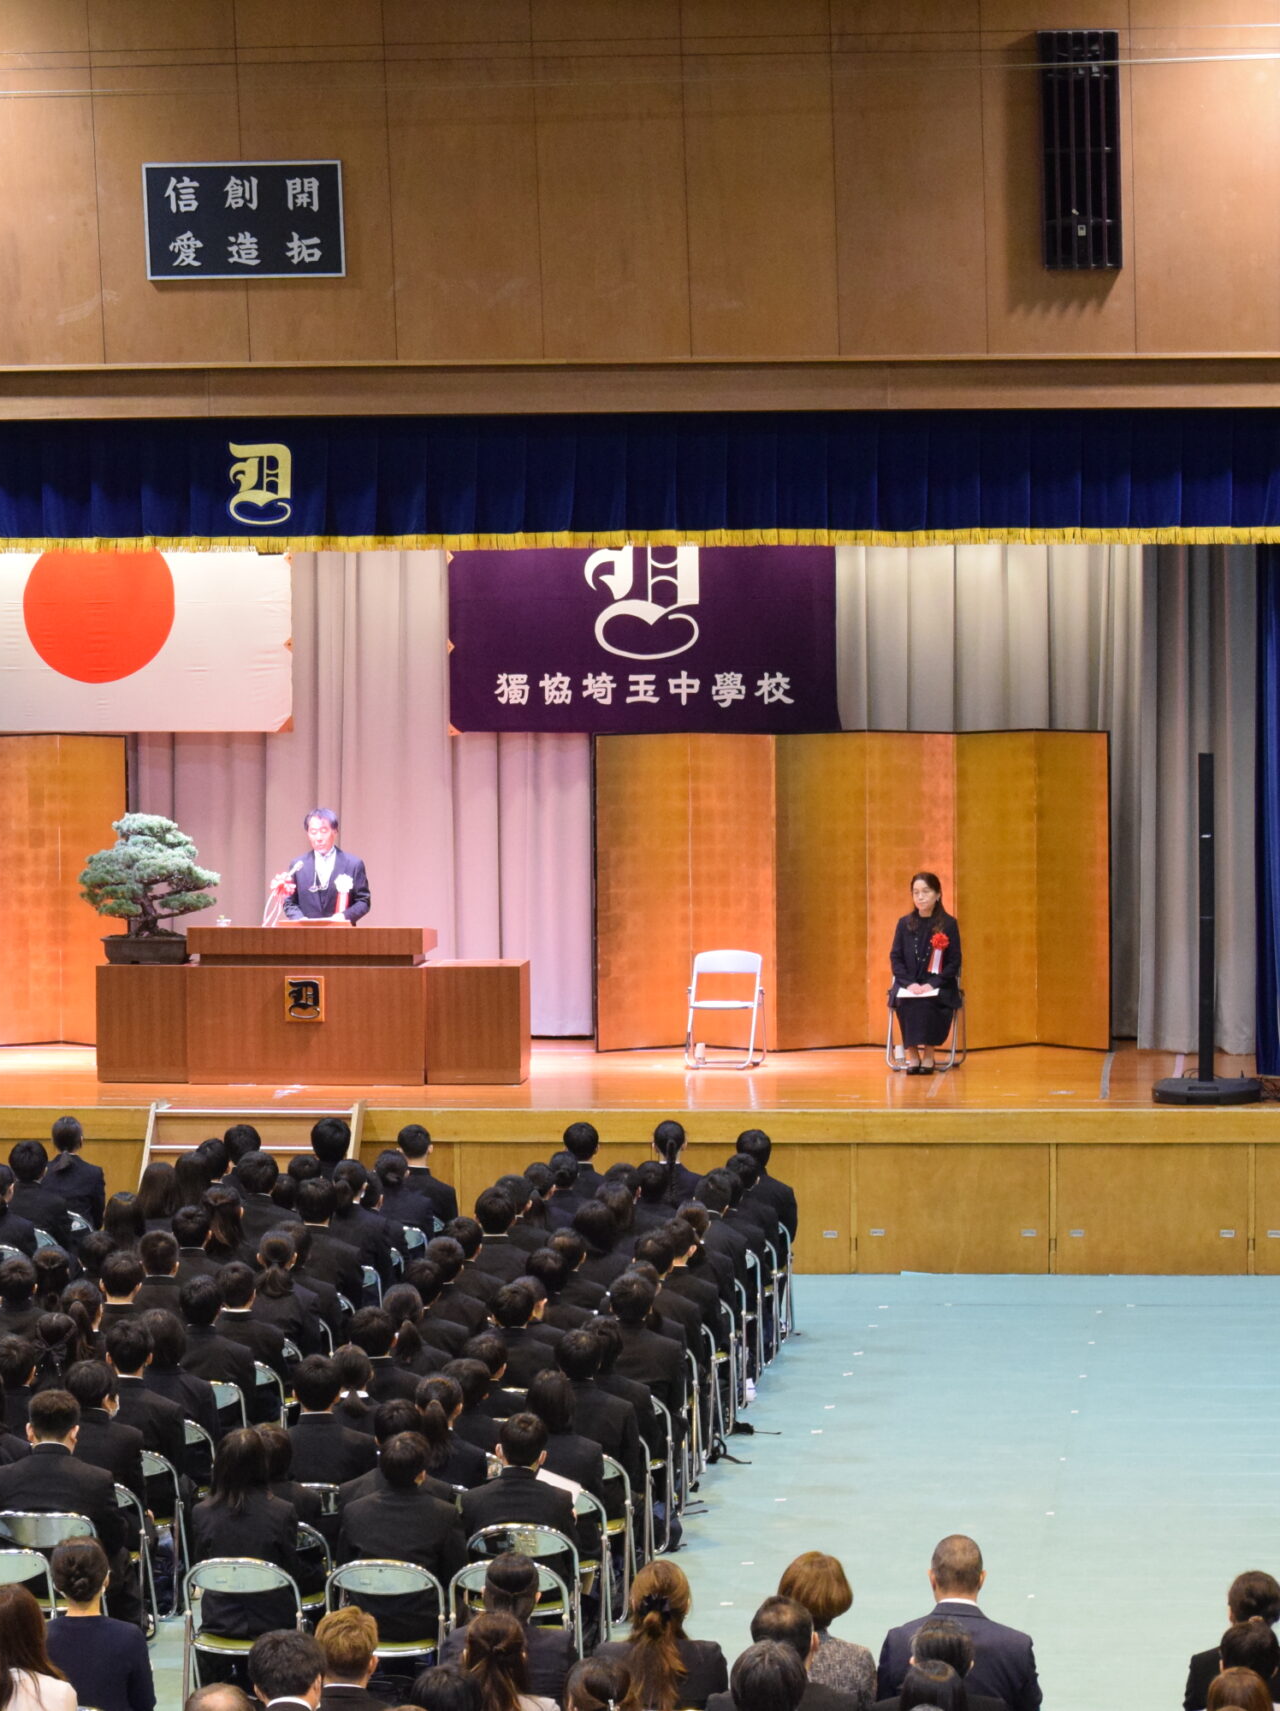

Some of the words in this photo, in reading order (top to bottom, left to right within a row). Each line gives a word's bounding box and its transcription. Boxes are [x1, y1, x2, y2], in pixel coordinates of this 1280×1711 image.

[164, 176, 204, 267] 信愛
[224, 176, 261, 266] 創造
[286, 177, 322, 265] 開拓
